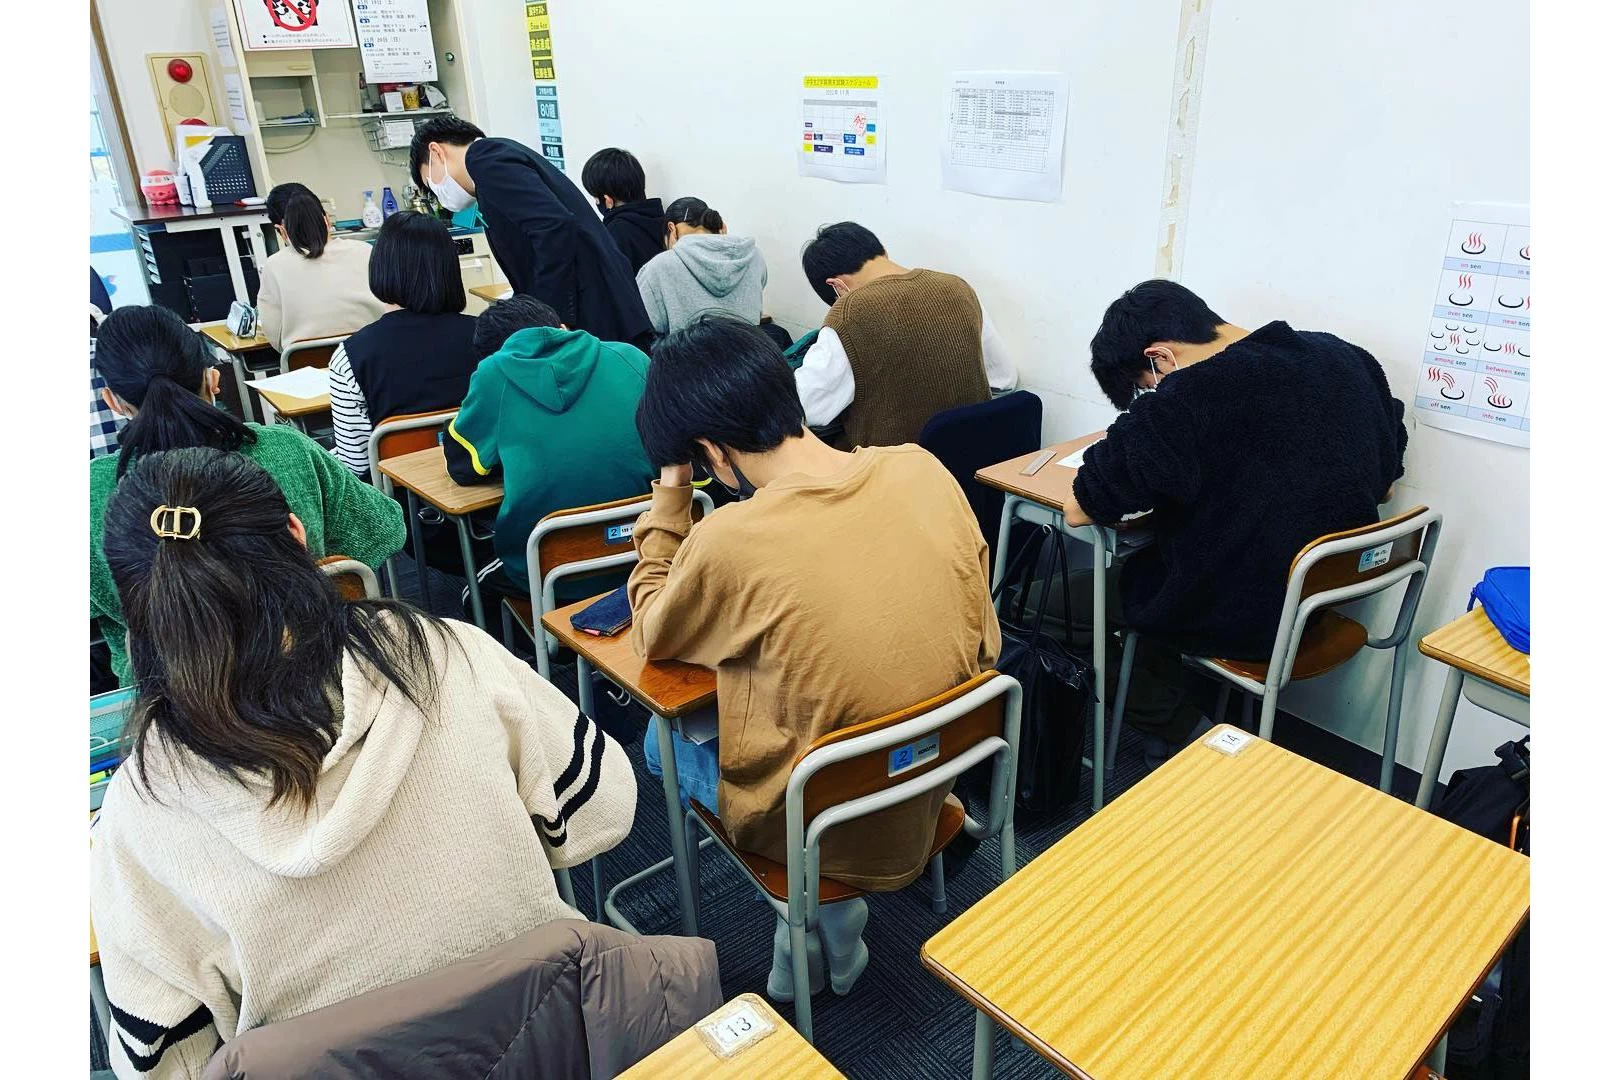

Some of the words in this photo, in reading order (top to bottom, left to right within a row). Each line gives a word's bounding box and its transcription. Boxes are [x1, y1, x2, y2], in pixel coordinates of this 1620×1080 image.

[1434, 357, 1455, 365] among
[1485, 365, 1513, 374] between
[611, 528, 618, 537] 2
[1365, 552, 1372, 562] 2
[898, 750, 909, 763] 2
[726, 1017, 752, 1037] 13
